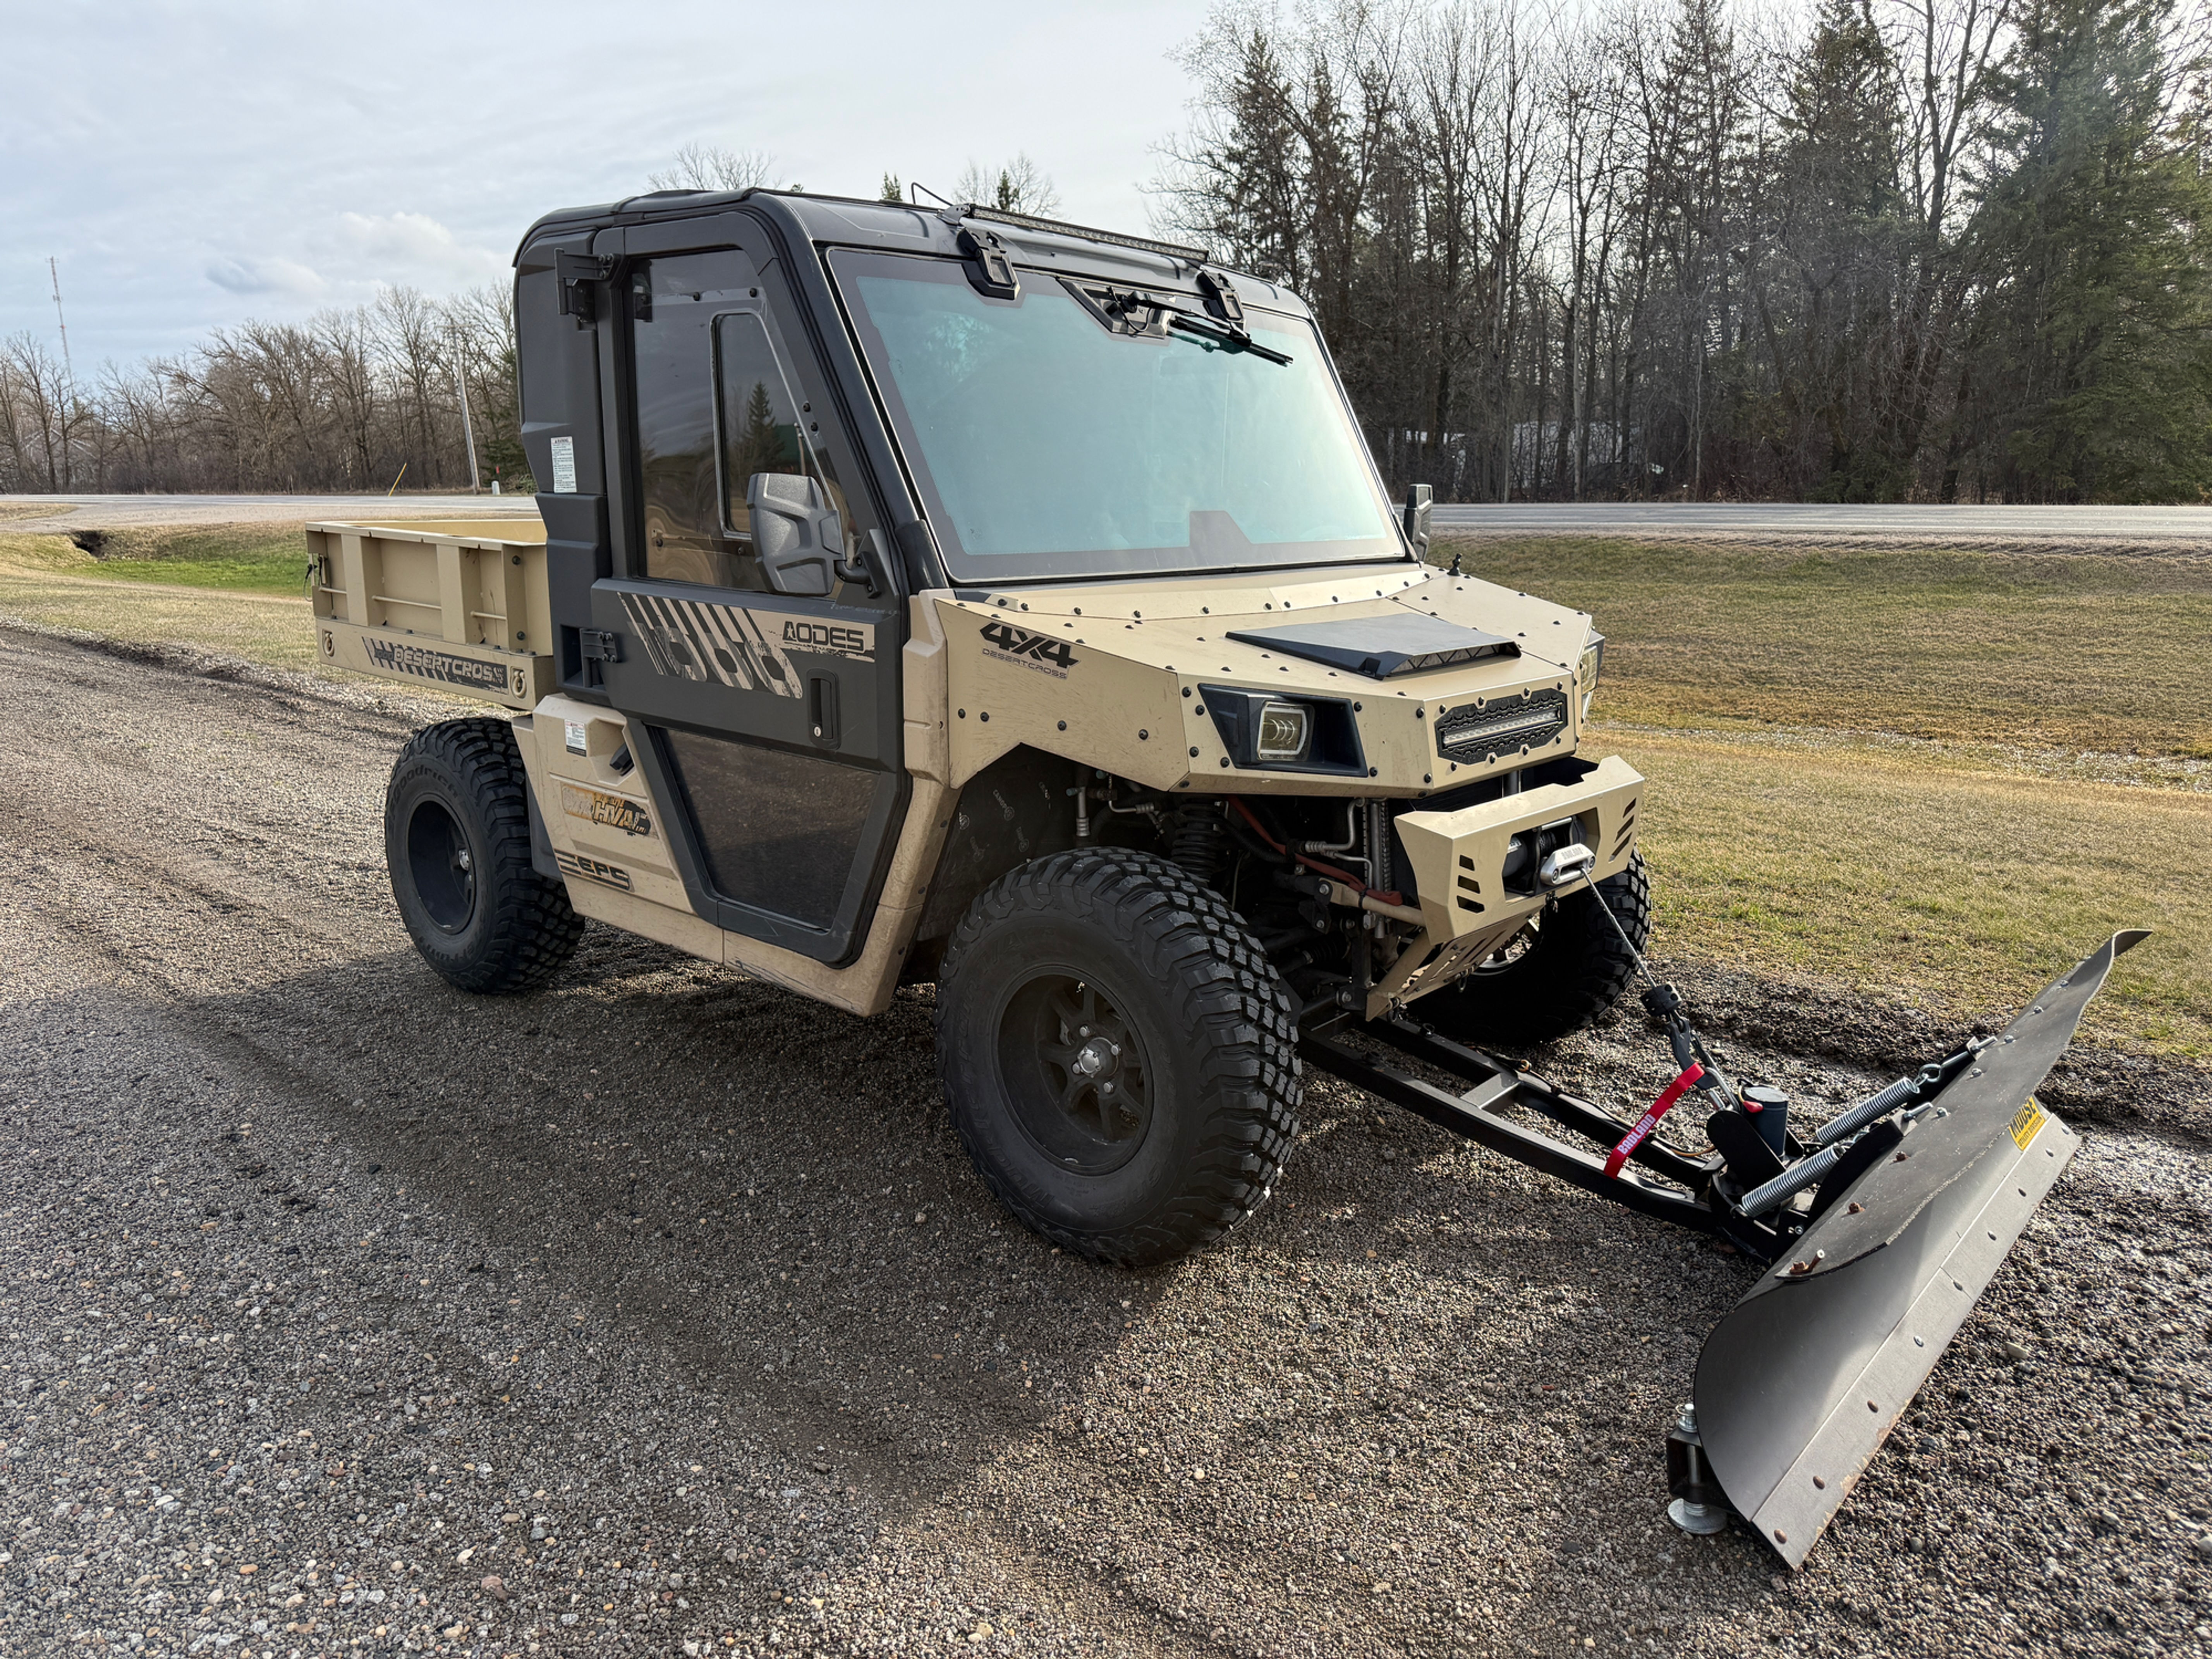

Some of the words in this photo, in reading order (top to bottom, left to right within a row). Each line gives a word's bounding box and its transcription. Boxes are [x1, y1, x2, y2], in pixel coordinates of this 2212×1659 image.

[782, 621, 864, 651] AODES
[982, 648, 1067, 679] DESERTCROSS
[1617, 1113, 1656, 1155] BADLAND
